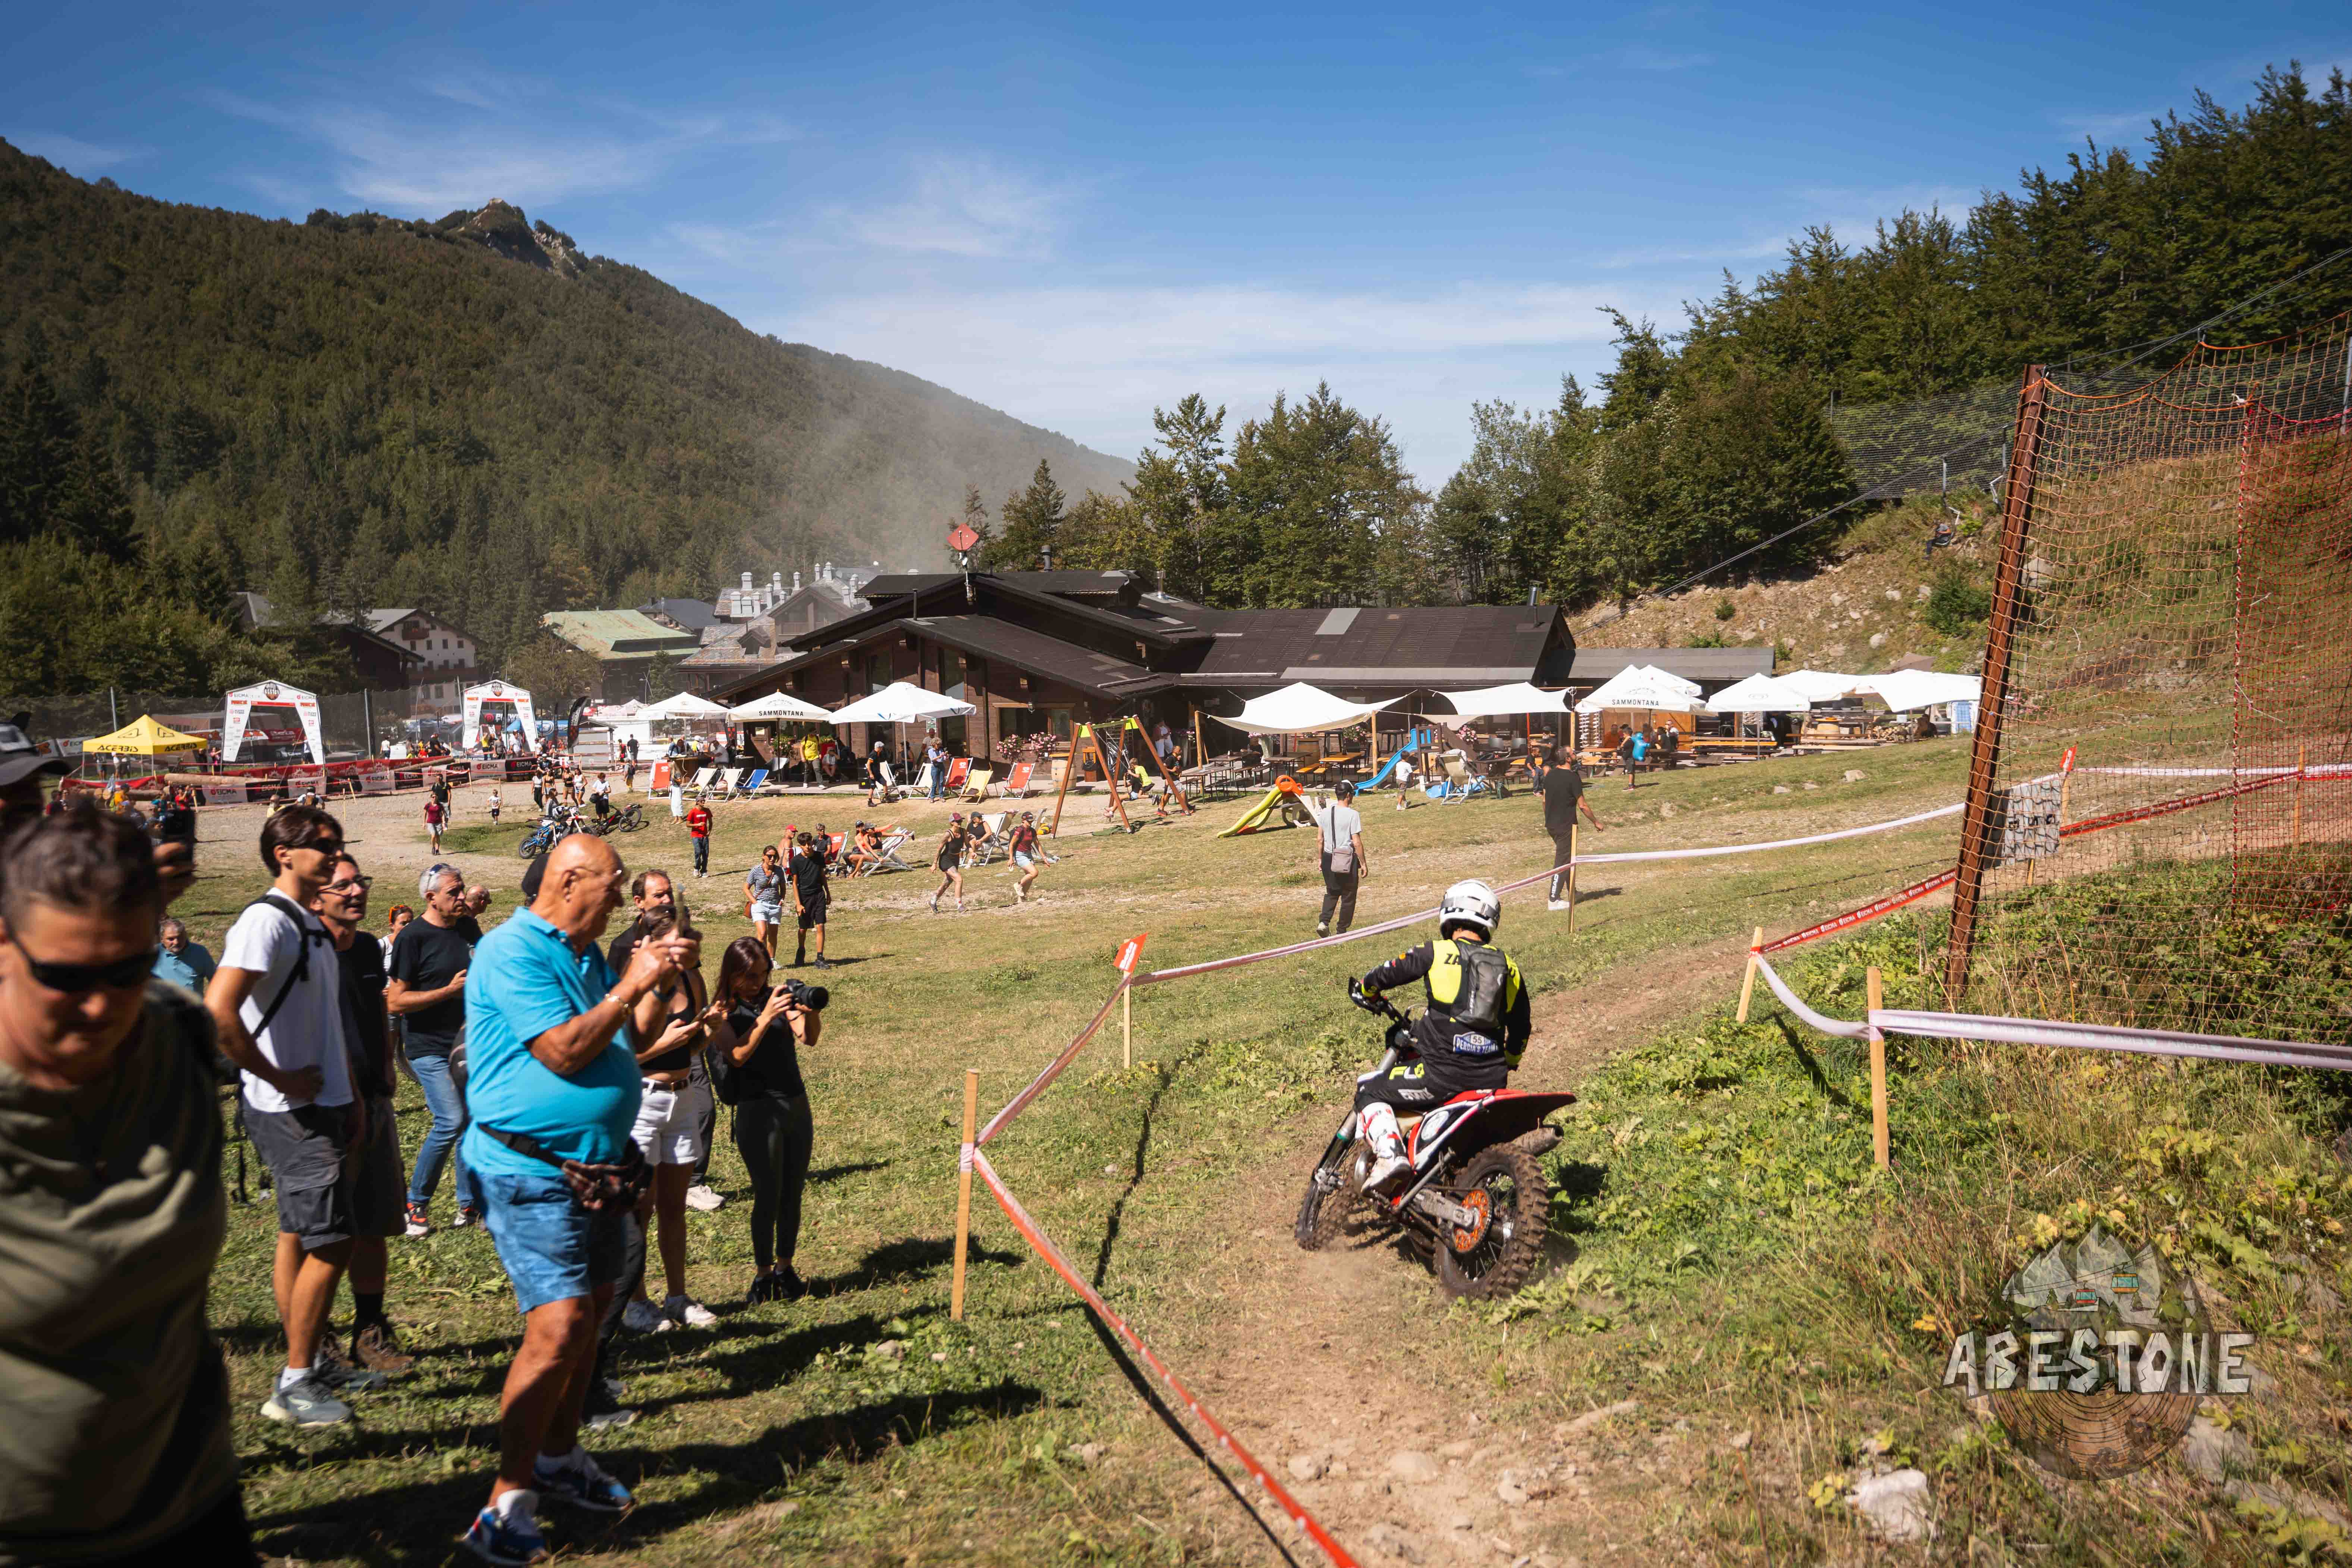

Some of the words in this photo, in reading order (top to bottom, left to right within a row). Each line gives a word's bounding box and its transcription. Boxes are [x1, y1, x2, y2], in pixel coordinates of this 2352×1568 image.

[164, 742, 197, 752] ACERBIS
[1878, 901, 1891, 910] EICMA
[1860, 908, 1874, 917] EICMA
[1842, 915, 1856, 924] EICMA
[1824, 922, 1838, 930] EICMA
